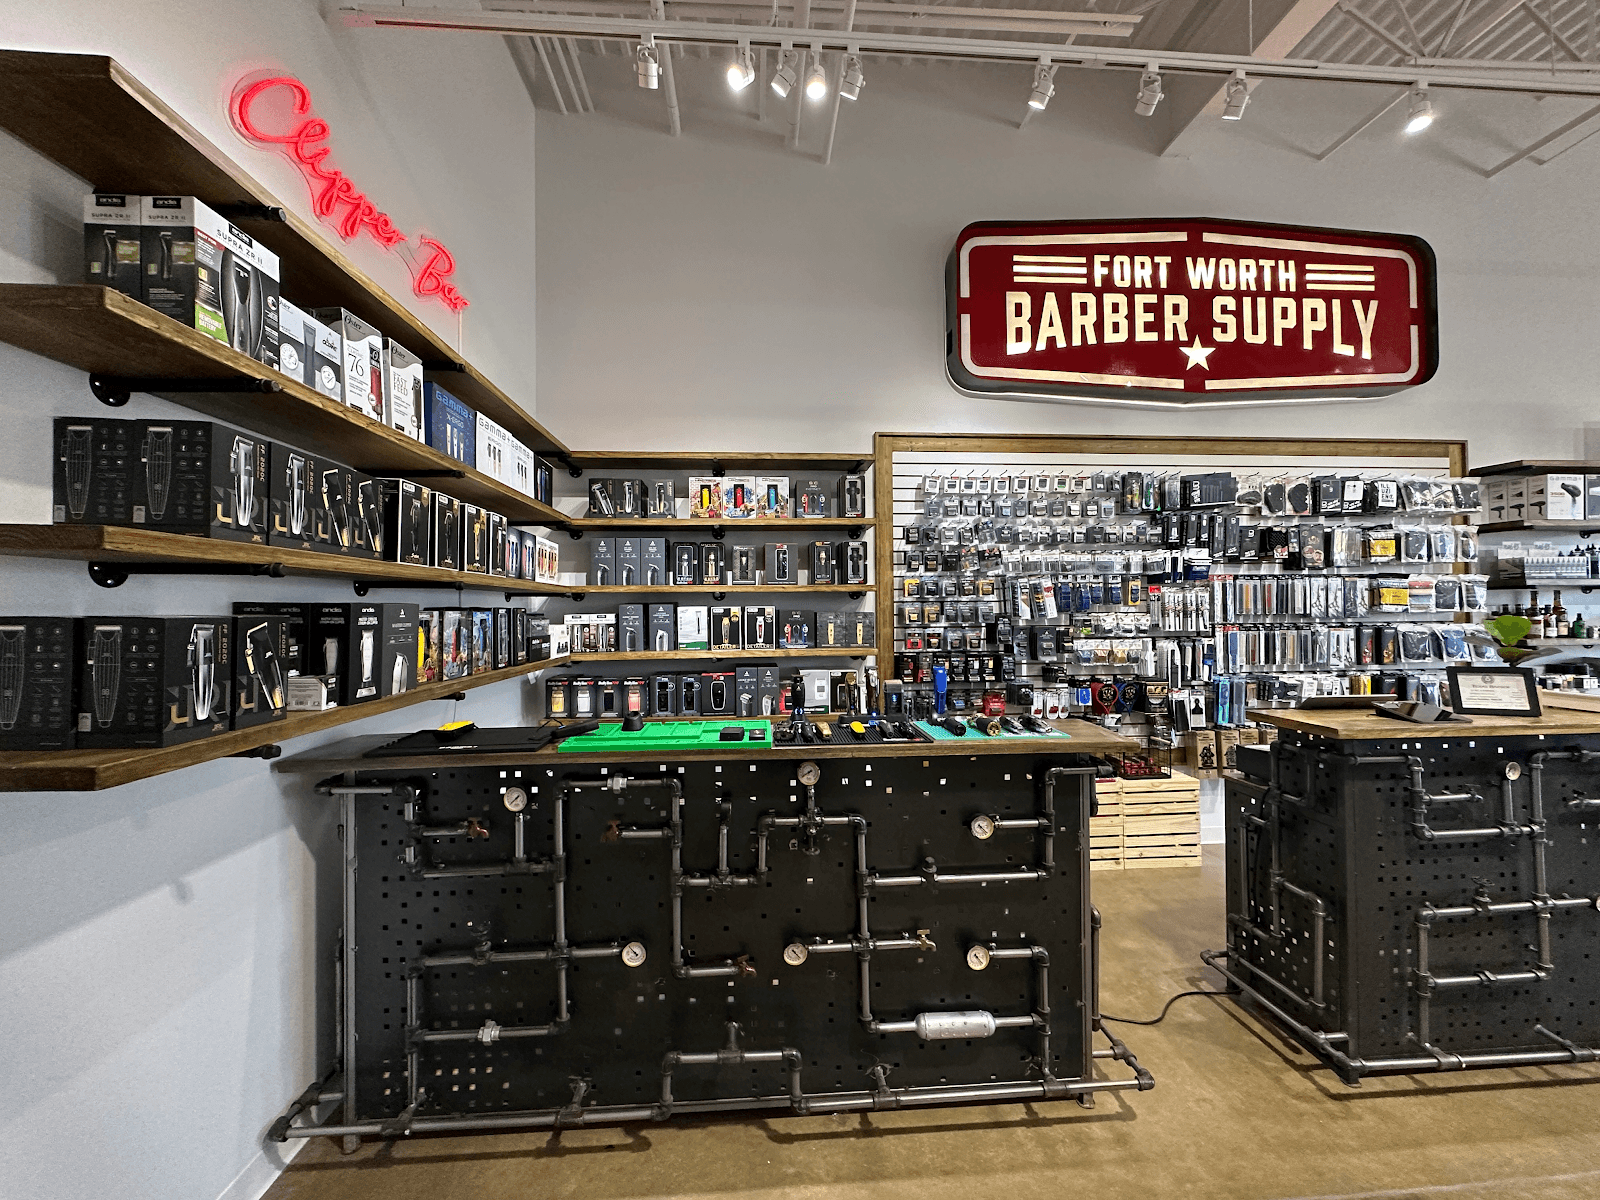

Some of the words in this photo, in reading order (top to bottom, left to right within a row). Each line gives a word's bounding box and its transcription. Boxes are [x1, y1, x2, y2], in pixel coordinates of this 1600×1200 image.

[216, 229, 244, 251] SUPRA
[414, 237, 470, 310] Bar
[1094, 255, 1172, 288] FORT
[1186, 256, 1296, 292] WORTH
[344, 314, 362, 330] Oster
[1006, 291, 1189, 355] BARBER
[1212, 295, 1379, 360] SUPPLY
[392, 345, 406, 359] Oster
[348, 352, 364, 377] 76
[393, 371, 407, 387] FAST
[393, 382, 408, 397] FEED
